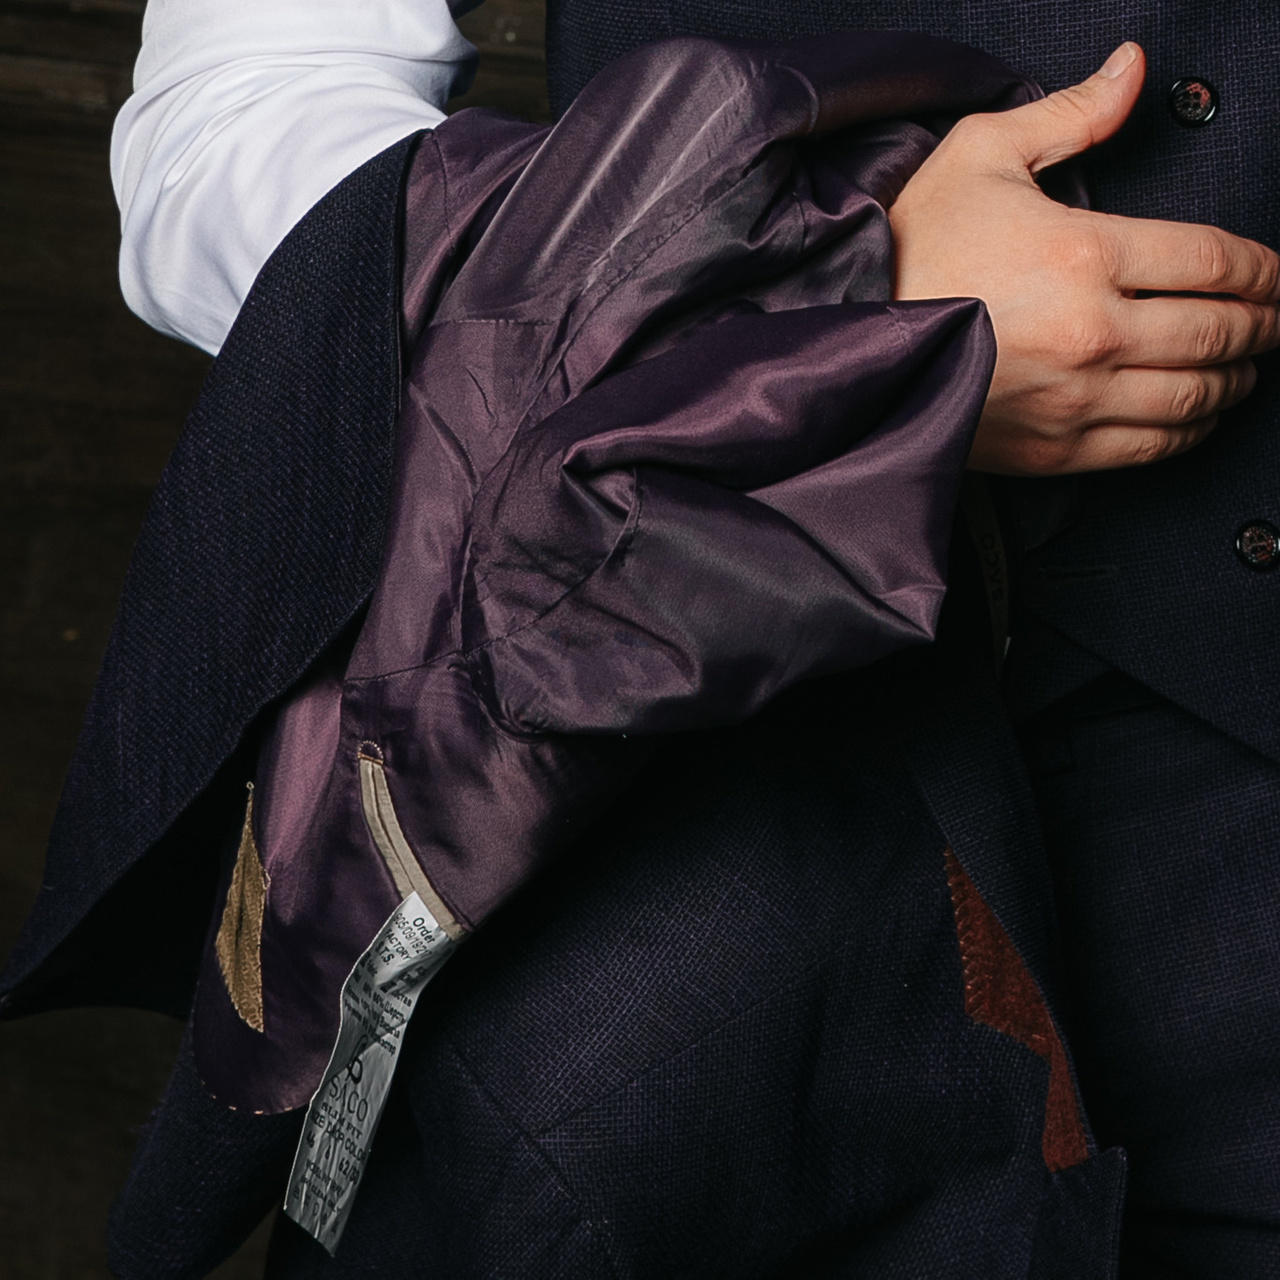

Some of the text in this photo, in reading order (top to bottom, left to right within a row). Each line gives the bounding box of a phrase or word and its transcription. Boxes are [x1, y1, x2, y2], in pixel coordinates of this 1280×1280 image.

[384, 929, 411, 960] FACTORY
[413, 917, 436, 944] Order
[328, 1074, 369, 1122] SACO
[321, 1101, 363, 1140] SLIM FIT
